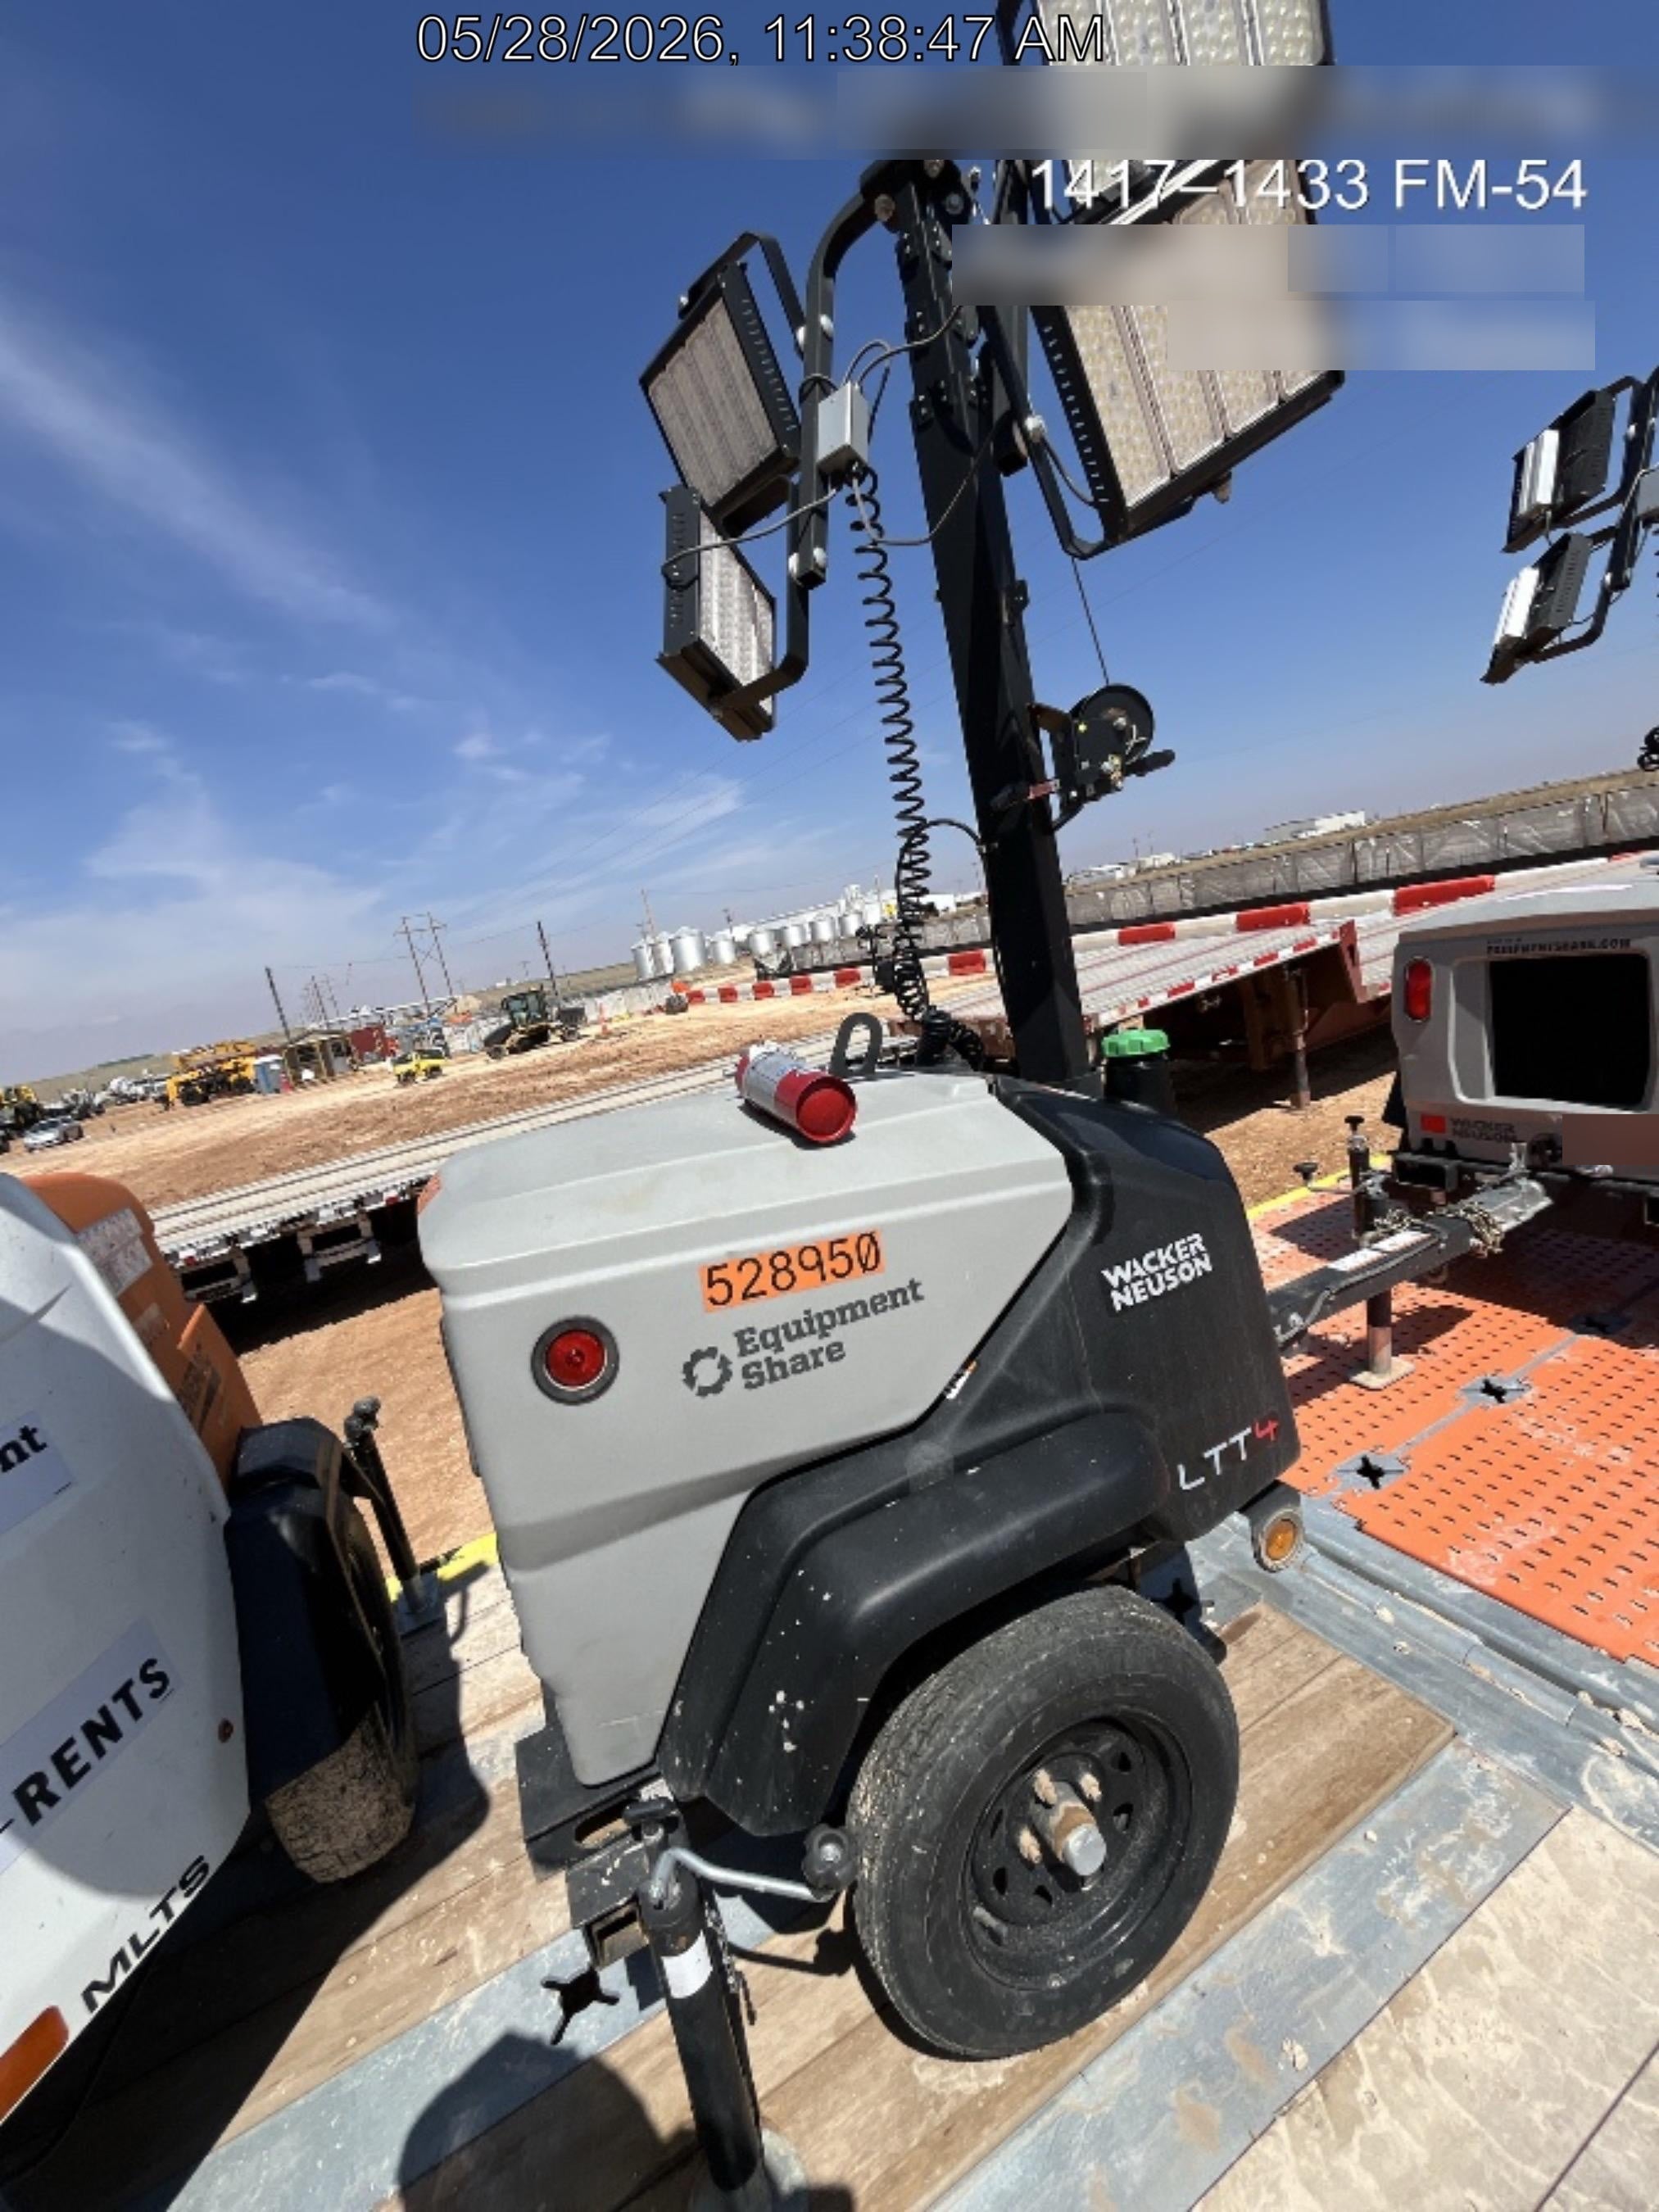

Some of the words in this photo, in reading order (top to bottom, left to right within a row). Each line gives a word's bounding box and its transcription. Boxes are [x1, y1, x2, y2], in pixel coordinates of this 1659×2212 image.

[706, 1231, 881, 1307] 528950
[1101, 1232, 1207, 1289] WACKER
[1109, 1253, 1213, 1312] NEUSON
[733, 1277, 925, 1358] Equipment
[741, 1340, 846, 1390] Share
[1176, 1419, 1279, 1491] LTT4
[81, 1855, 210, 2013] MLTS
